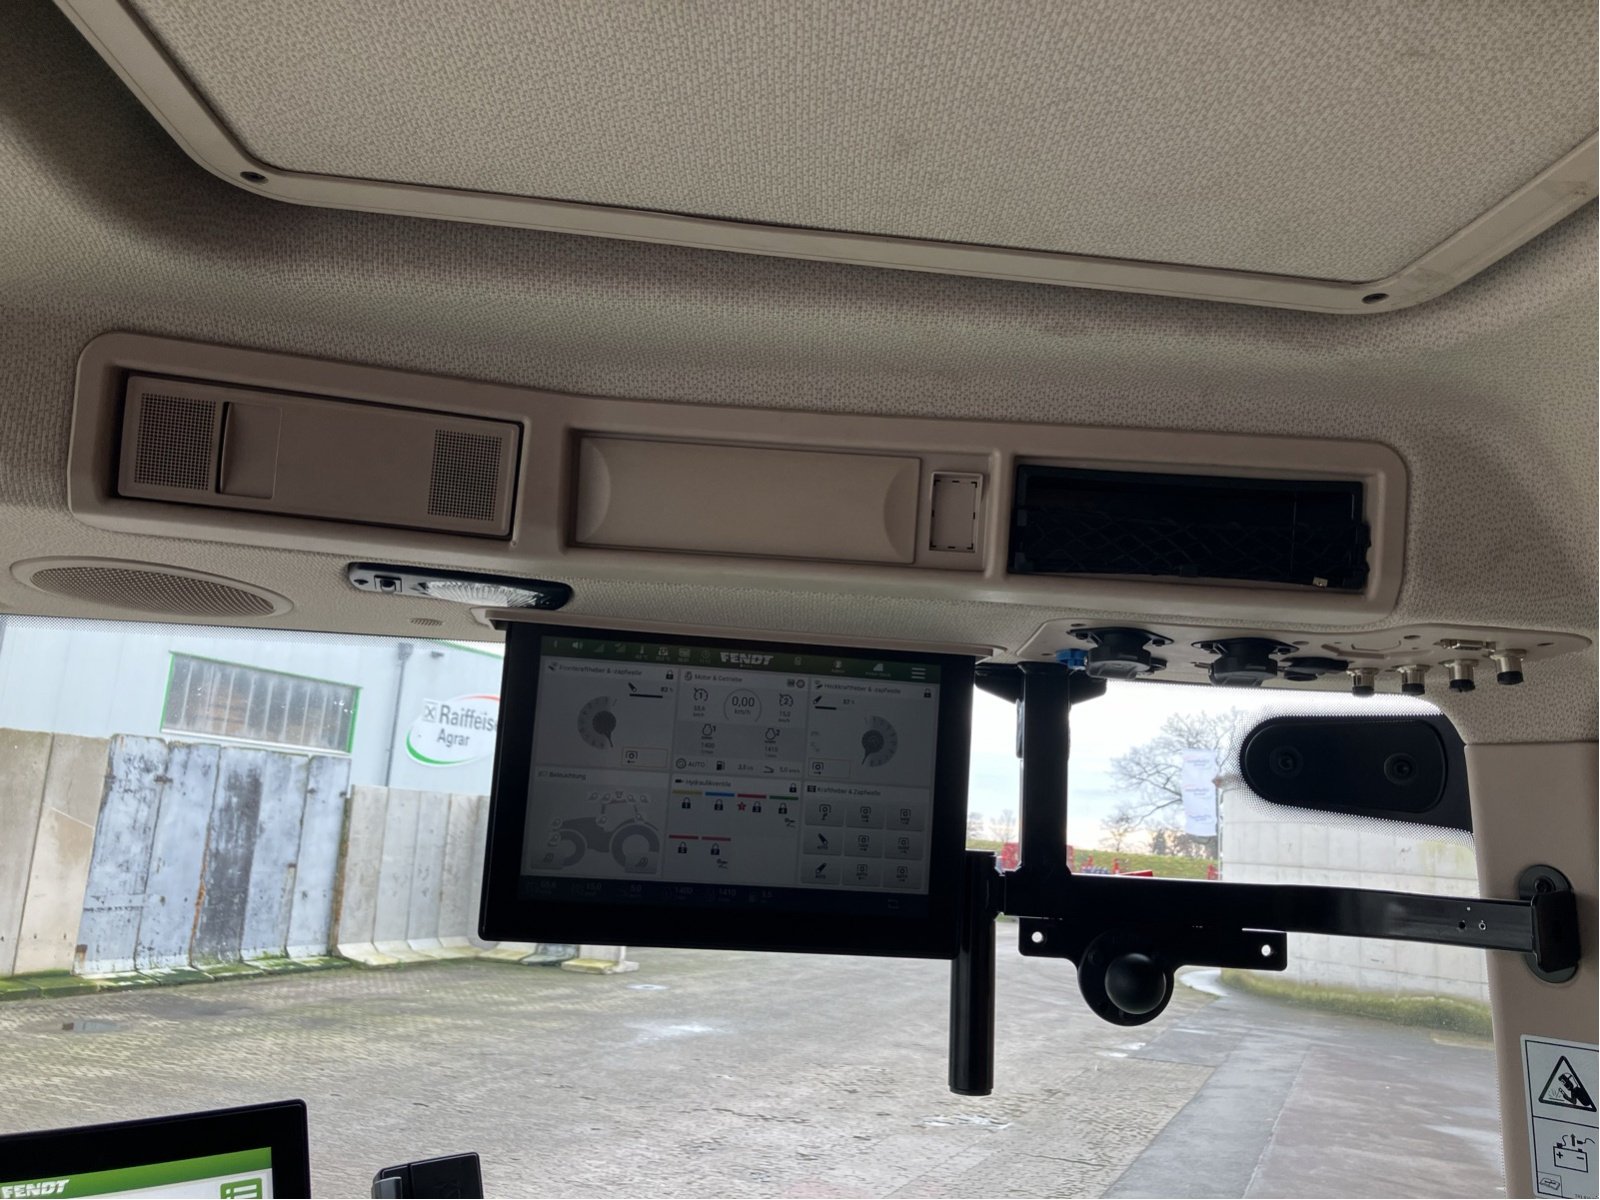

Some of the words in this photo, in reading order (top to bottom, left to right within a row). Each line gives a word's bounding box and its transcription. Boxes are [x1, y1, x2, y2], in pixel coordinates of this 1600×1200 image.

[720, 651, 774, 666] FENDT
[718, 675, 743, 683] Getriebe
[732, 695, 755, 708] 0,00
[436, 727, 471, 748] Agrar
[549, 771, 586, 781] Beleuchtung
[686, 779, 731, 787] Hydraulikventile
[818, 787, 847, 795] Kraftheber
[853, 789, 881, 797] Zapfwelle
[1, 1178, 70, 1200] FENDT
